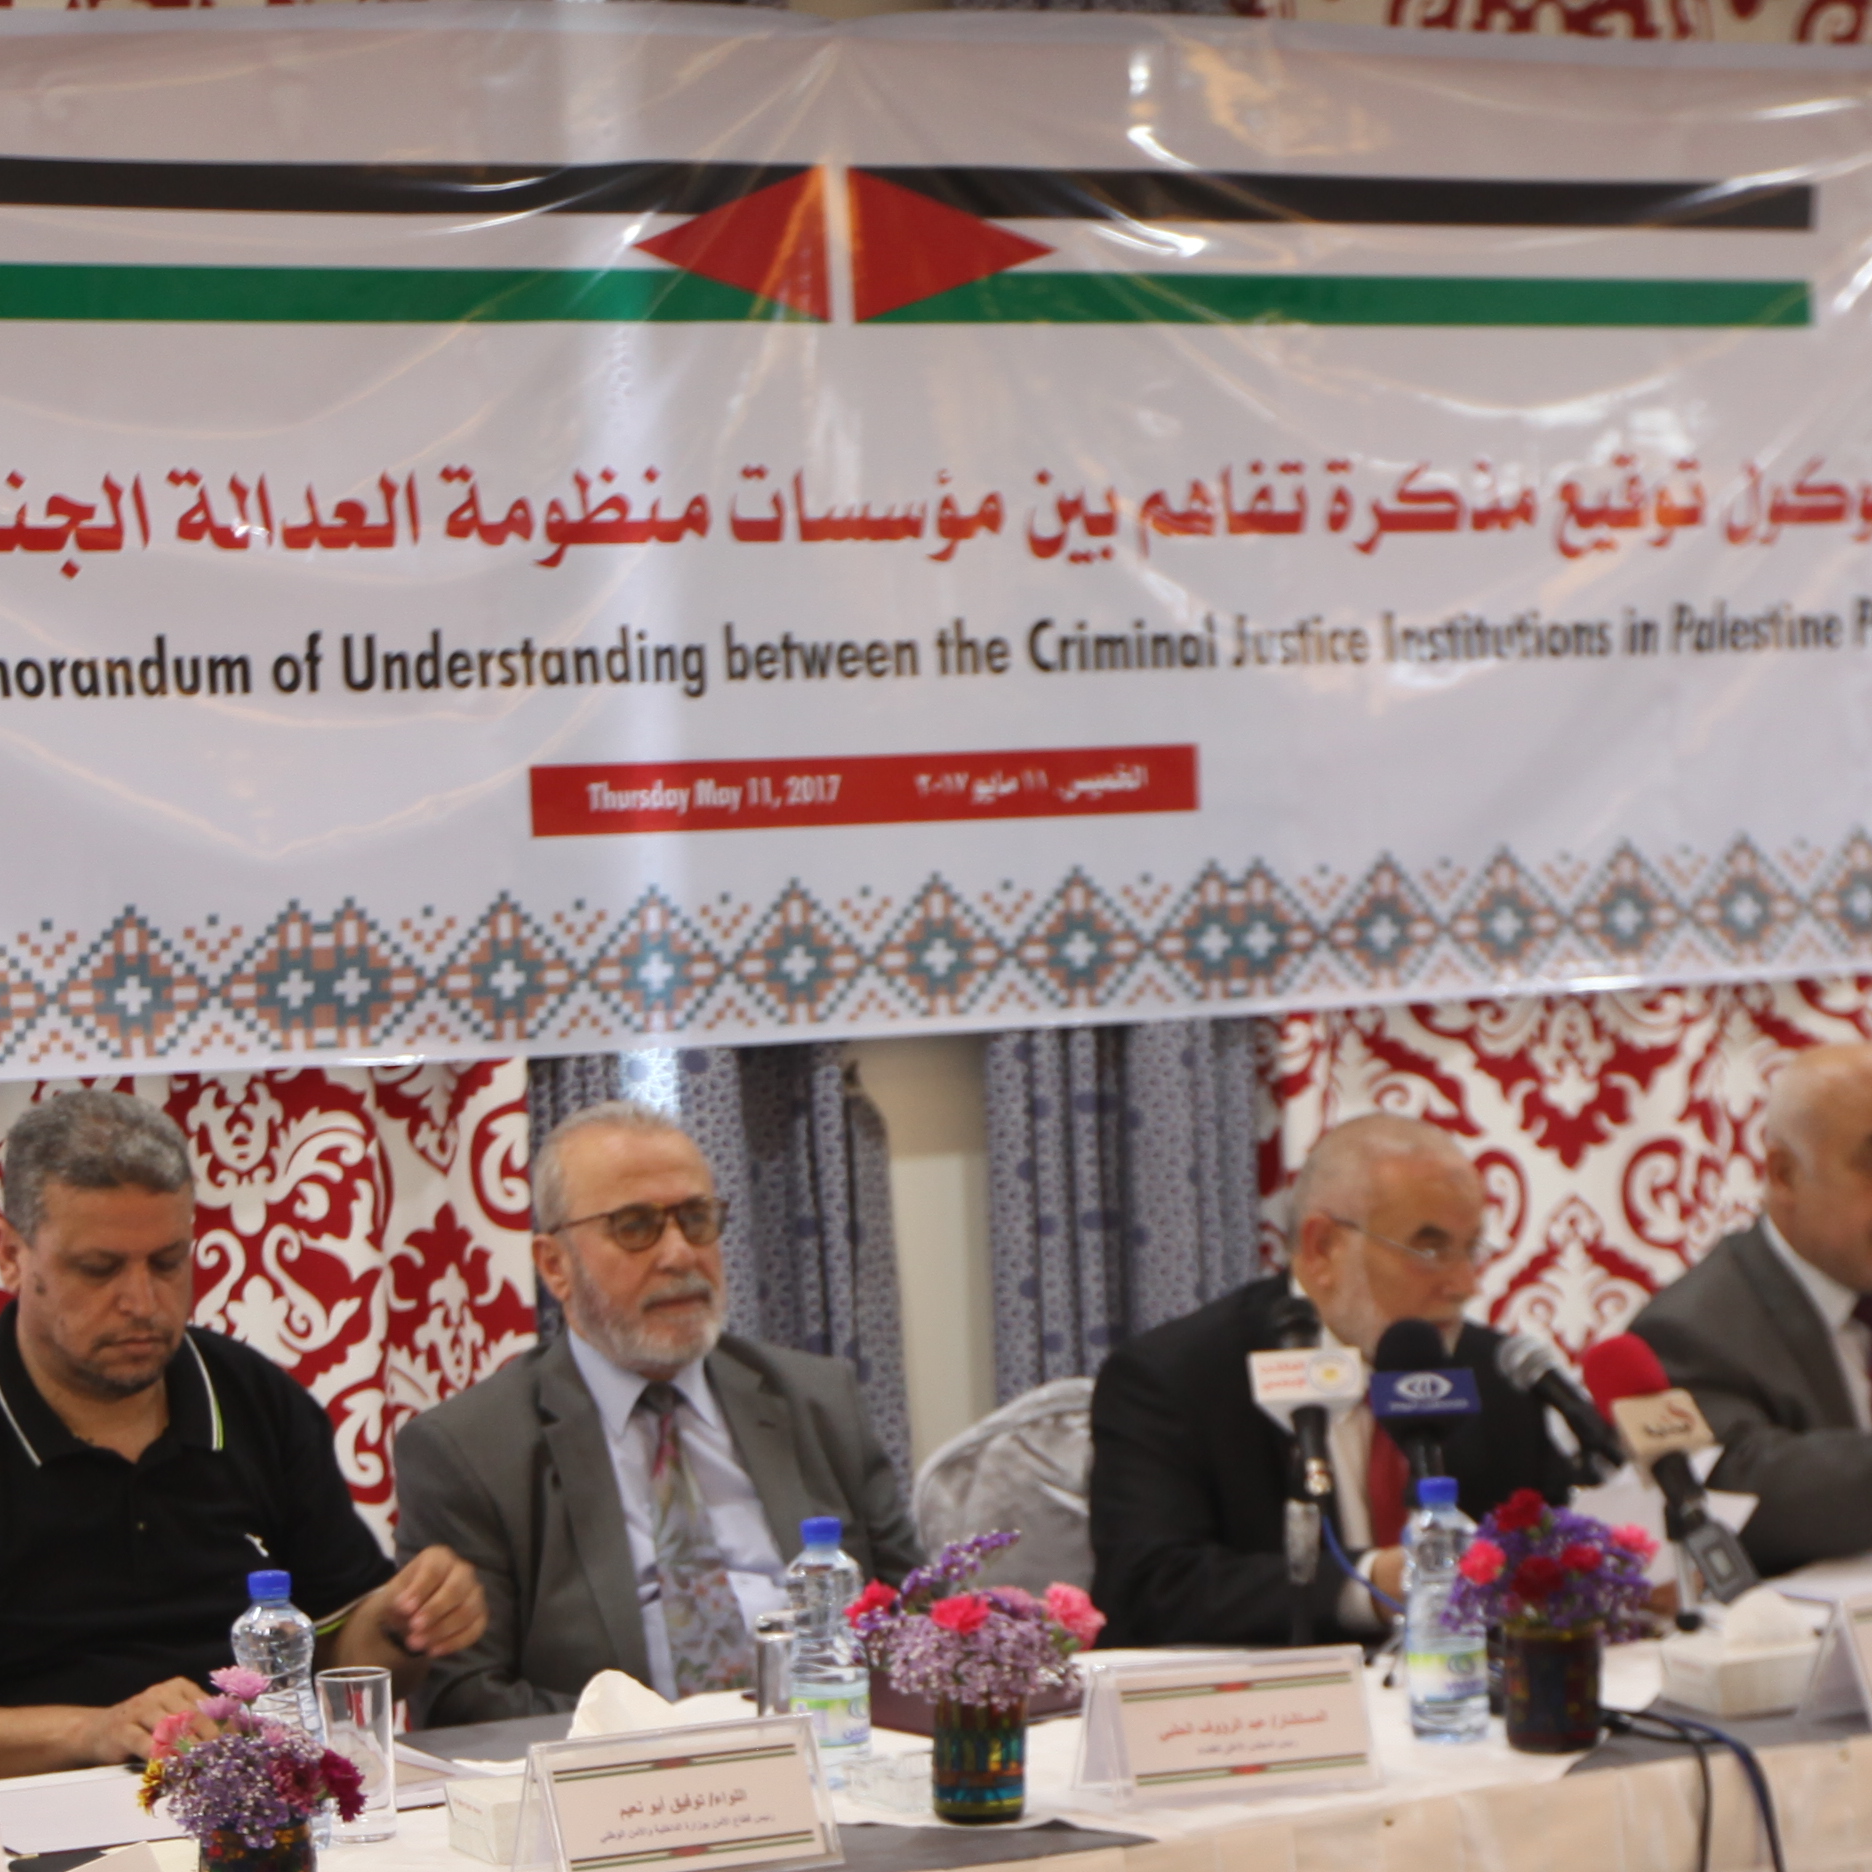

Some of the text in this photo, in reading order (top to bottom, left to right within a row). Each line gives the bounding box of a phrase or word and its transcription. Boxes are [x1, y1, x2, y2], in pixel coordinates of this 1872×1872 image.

[165, 465, 421, 551] العدالة
[439, 466, 711, 568] منظومة
[730, 467, 1004, 562] مؤسسات
[1027, 471, 1120, 564] بين
[1136, 460, 1309, 557] تفاهم
[1325, 460, 1538, 555] مذكرة
[1557, 454, 1706, 560] توقيع
[272, 631, 322, 694] of
[342, 625, 707, 698] Understanding
[724, 623, 919, 681] between
[936, 618, 1010, 675] the
[1026, 614, 1216, 673] Criminal
[1232, 615, 1368, 668] Justice
[1382, 611, 1612, 662] Institutions
[1623, 609, 1659, 656] in
[1666, 602, 1844, 655] Palestine
[586, 774, 842, 816] Thursday May 11, 2017
[669, 1792, 706, 1815] توفيق
